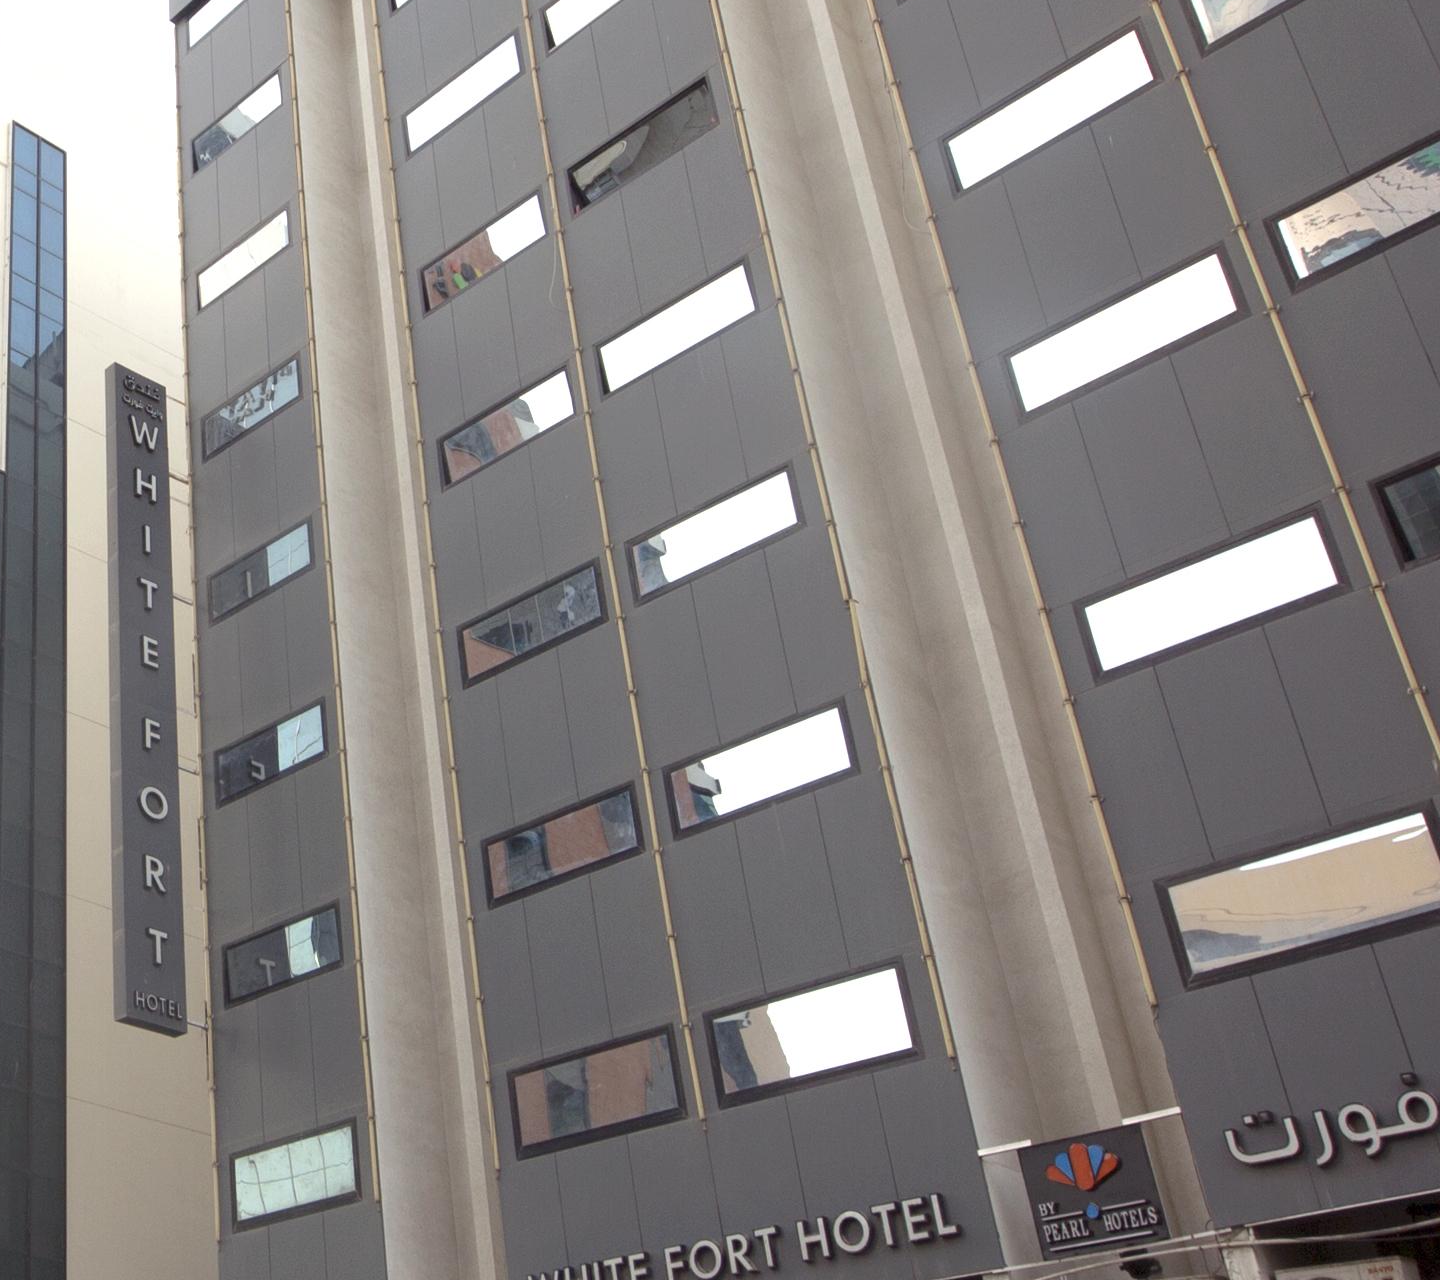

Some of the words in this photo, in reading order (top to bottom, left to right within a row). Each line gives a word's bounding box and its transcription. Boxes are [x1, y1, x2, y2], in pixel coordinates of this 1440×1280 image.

[128, 415, 162, 671] WHITE
[139, 718, 170, 967] FORT
[133, 989, 183, 1020] HOTEL
[1224, 1071, 1440, 1167] فورت
[796, 1192, 961, 1262] HOTEL
[1039, 1201, 1056, 1217] BY
[1042, 1222, 1089, 1244] PEARL
[1104, 1206, 1158, 1231] HOTELS
